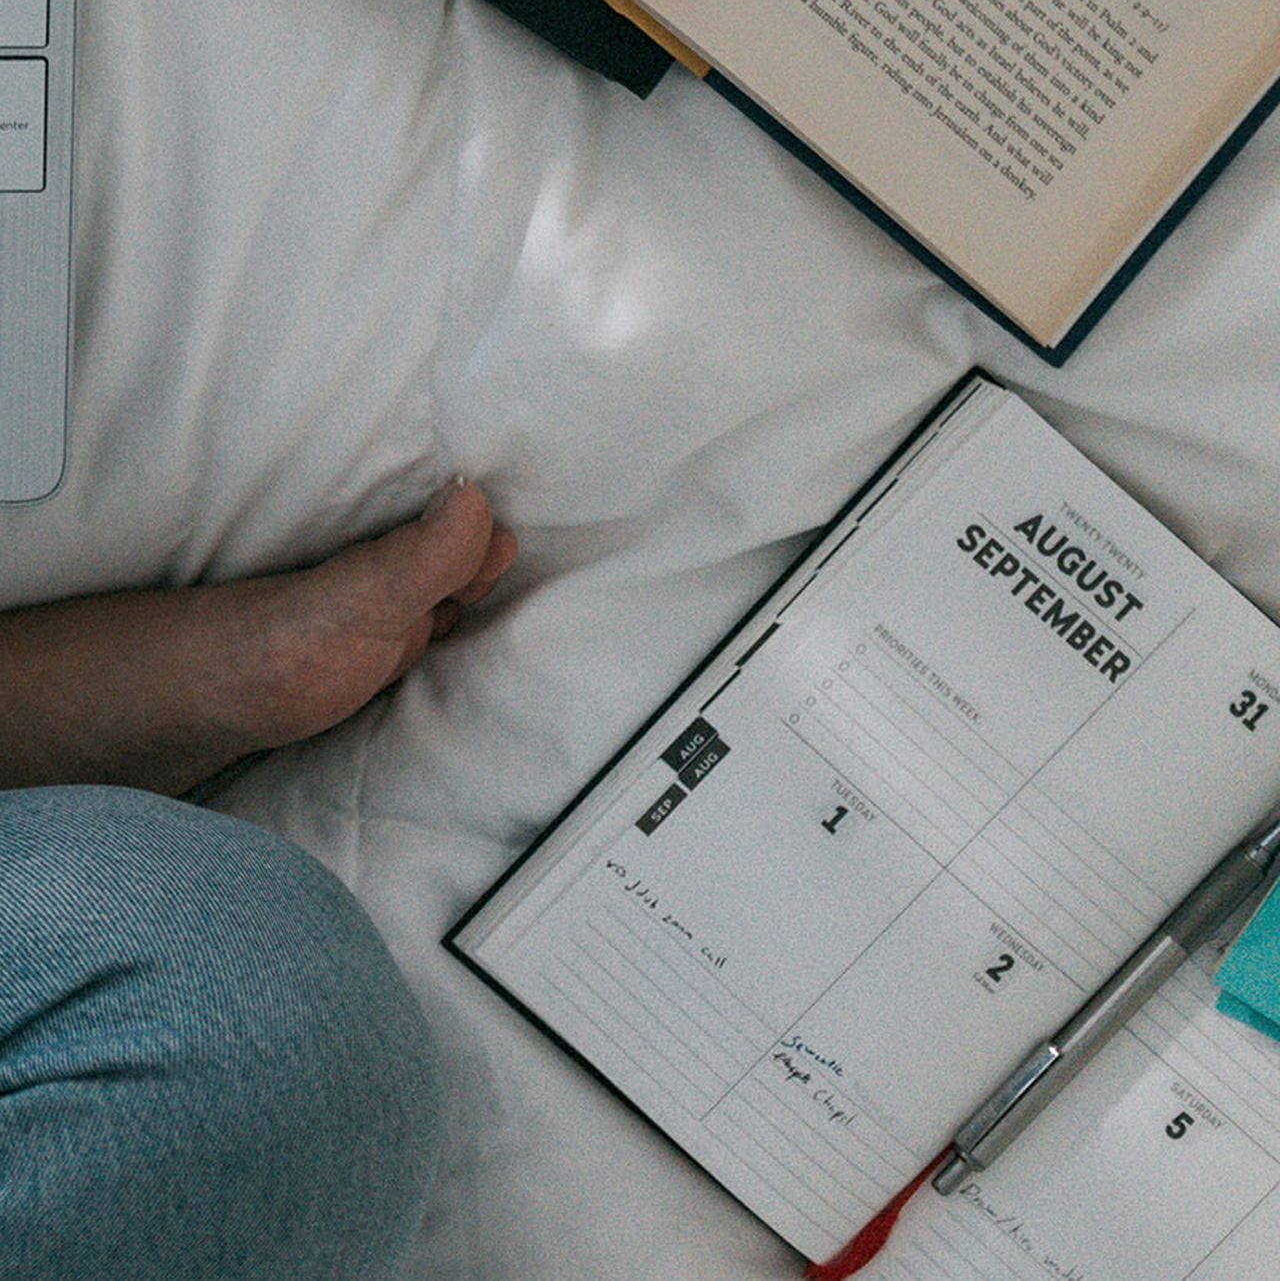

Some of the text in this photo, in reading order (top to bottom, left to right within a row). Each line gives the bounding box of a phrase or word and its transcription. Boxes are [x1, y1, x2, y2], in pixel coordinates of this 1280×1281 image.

[847, 32, 879, 66] figure,
[880, 62, 913, 94] riding
[911, 89, 933, 109] into
[928, 104, 979, 150] Jerusalem
[978, 148, 993, 162] on
[992, 160, 1000, 168] a
[999, 165, 1036, 200] donkey.
[1060, 501, 1144, 579] TWENTY TWENTY
[1013, 514, 1143, 622] AUGUST
[956, 524, 1131, 683] SEPTEMBER
[873, 623, 979, 721] PRIORITIES THIS WEEK
[1229, 690, 1269, 732] 31
[680, 734, 704, 760] AUG
[694, 752, 718, 778] AUG
[650, 798, 671, 821] SEP
[820, 805, 848, 835] 1
[831, 778, 875, 821] TUESDAY
[985, 953, 1015, 983] 2
[989, 923, 1044, 972] WEDNESDAY
[1165, 1111, 1194, 1140] 5
[1170, 1082, 1223, 1129] SATURDAY
